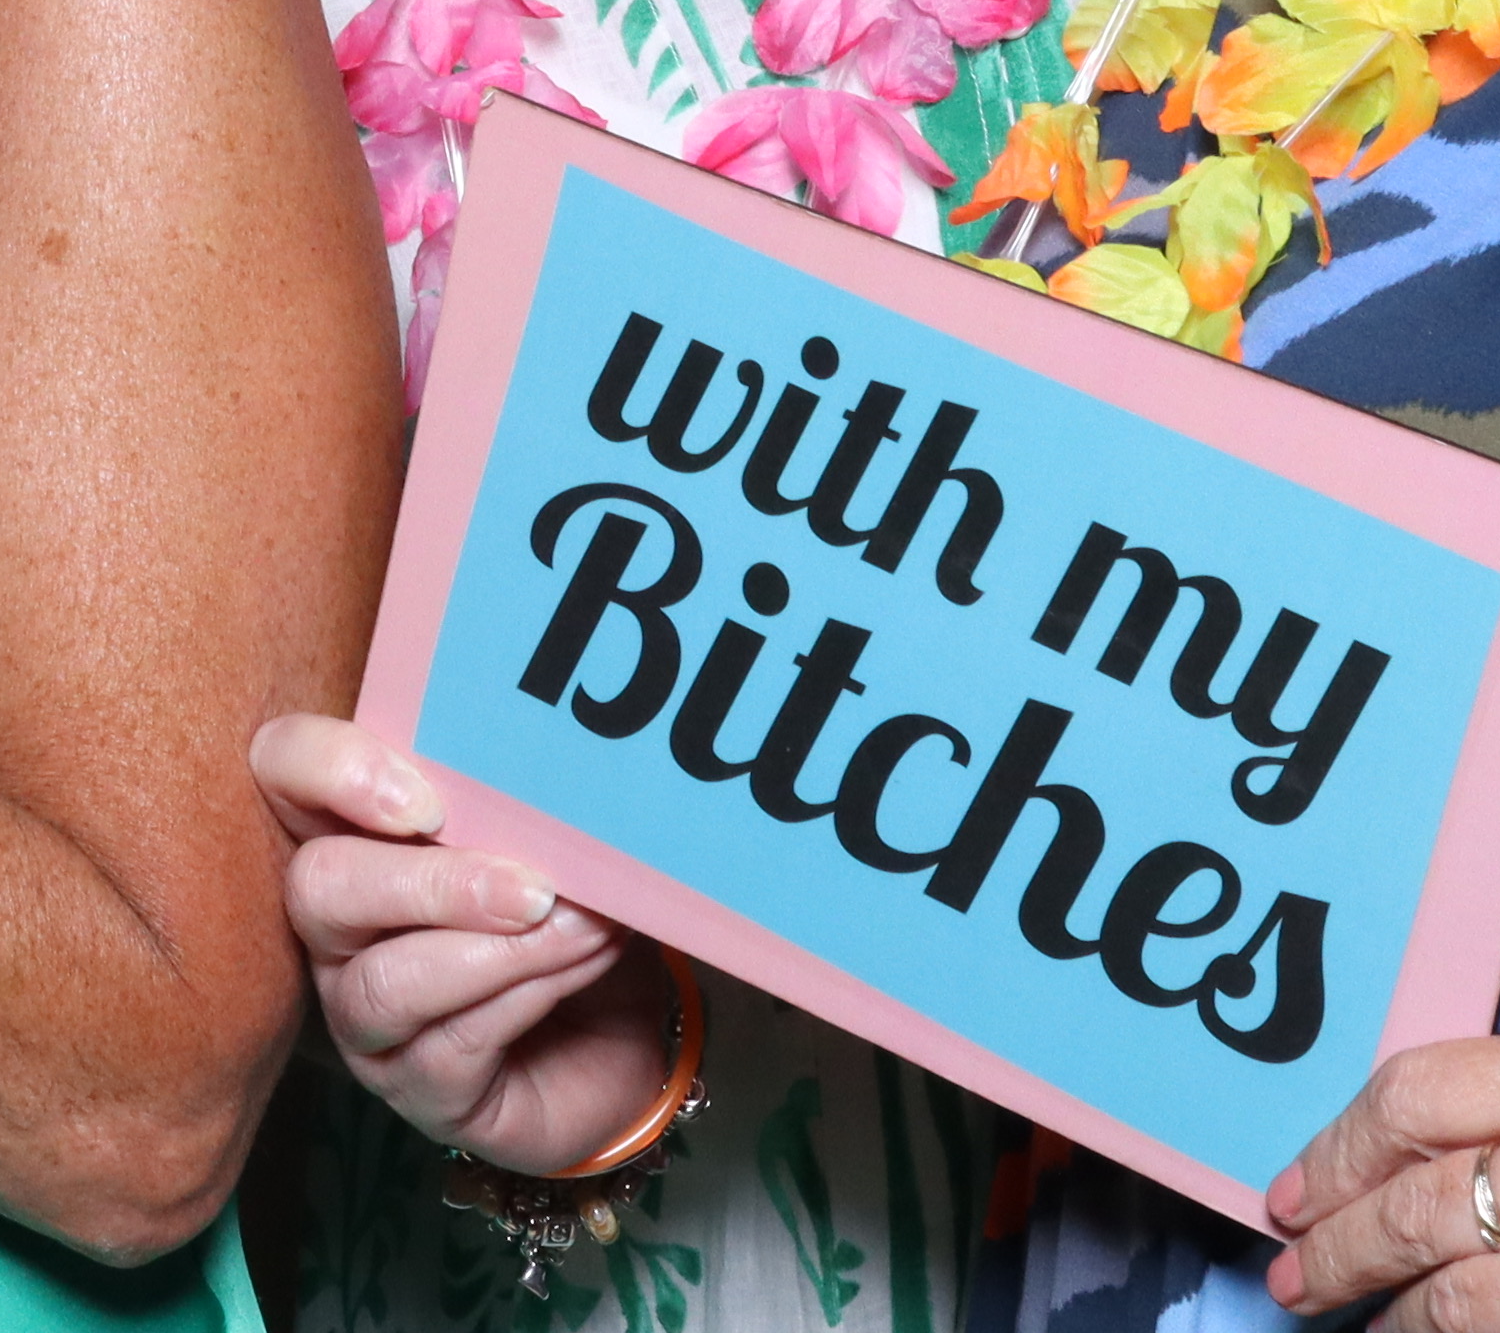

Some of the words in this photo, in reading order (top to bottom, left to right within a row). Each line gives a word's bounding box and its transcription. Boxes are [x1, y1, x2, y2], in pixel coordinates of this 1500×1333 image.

[516, 480, 1332, 1065] Bitches
[585, 310, 1005, 607] with
[1029, 520, 1393, 826] my
